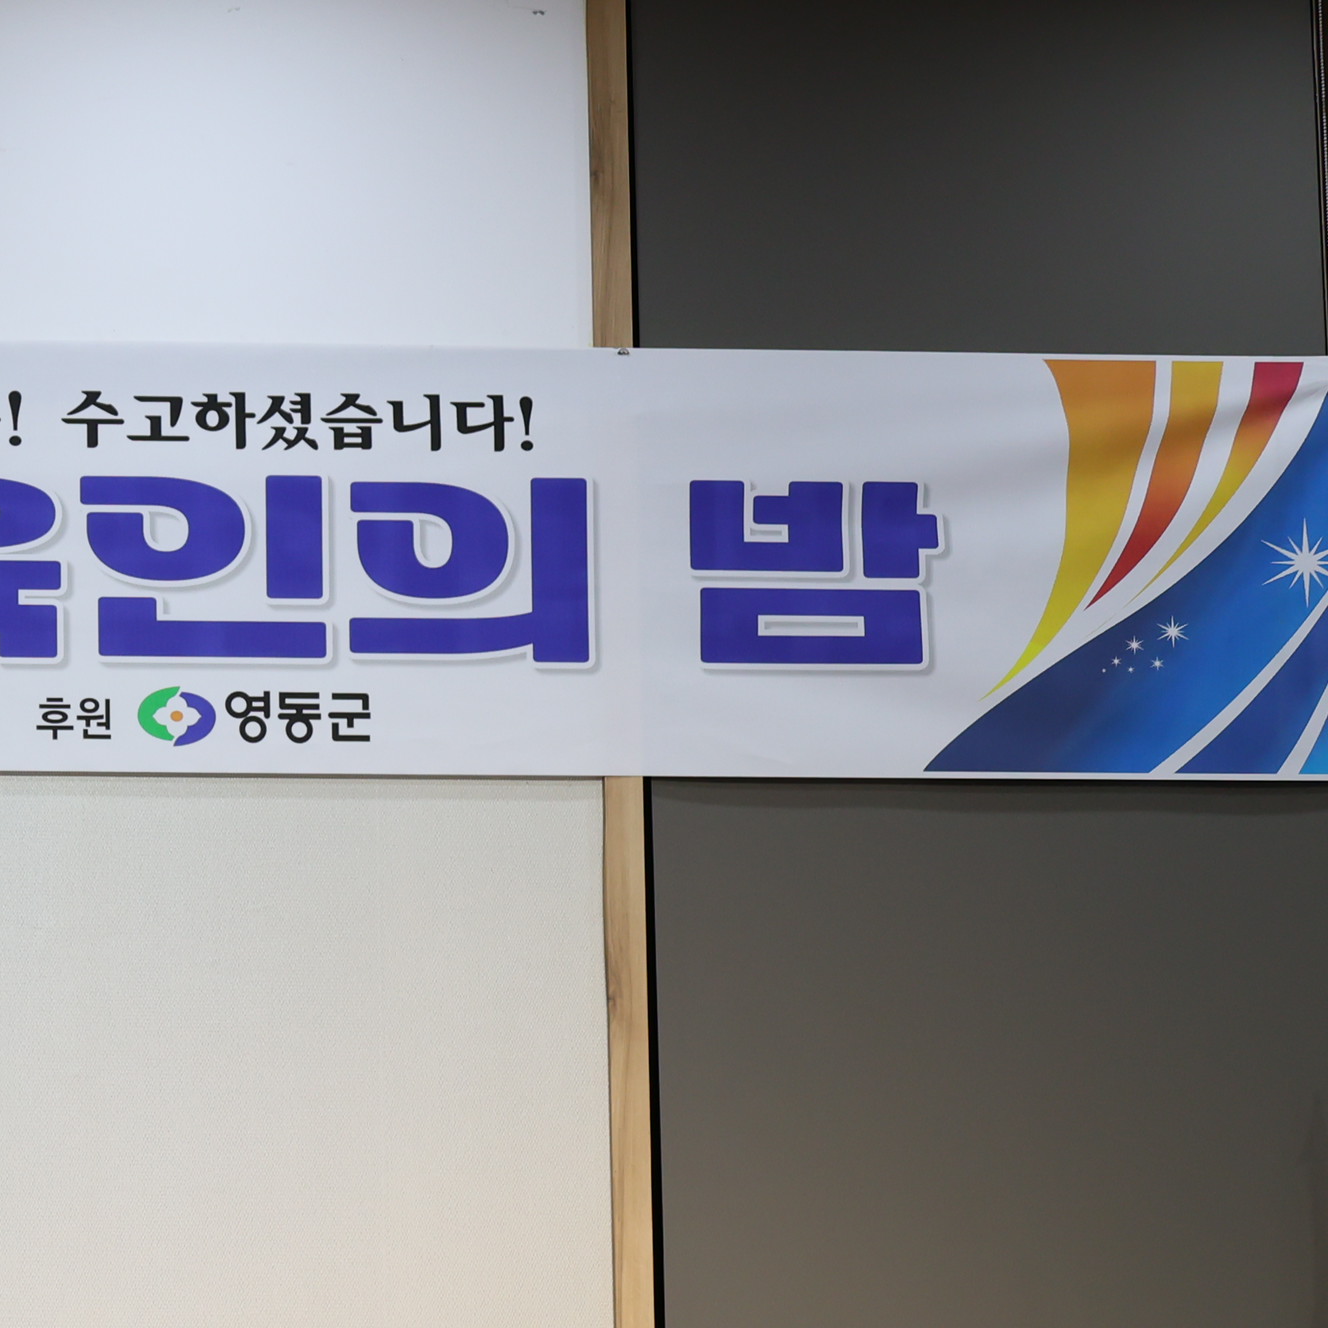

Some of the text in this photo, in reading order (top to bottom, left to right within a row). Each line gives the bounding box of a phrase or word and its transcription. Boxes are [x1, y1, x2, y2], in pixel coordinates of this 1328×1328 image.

[61, 390, 534, 452] 수고하셨습니다!
[688, 479, 940, 666] 밤
[36, 697, 113, 741] 후원
[224, 690, 372, 744] 영동군
